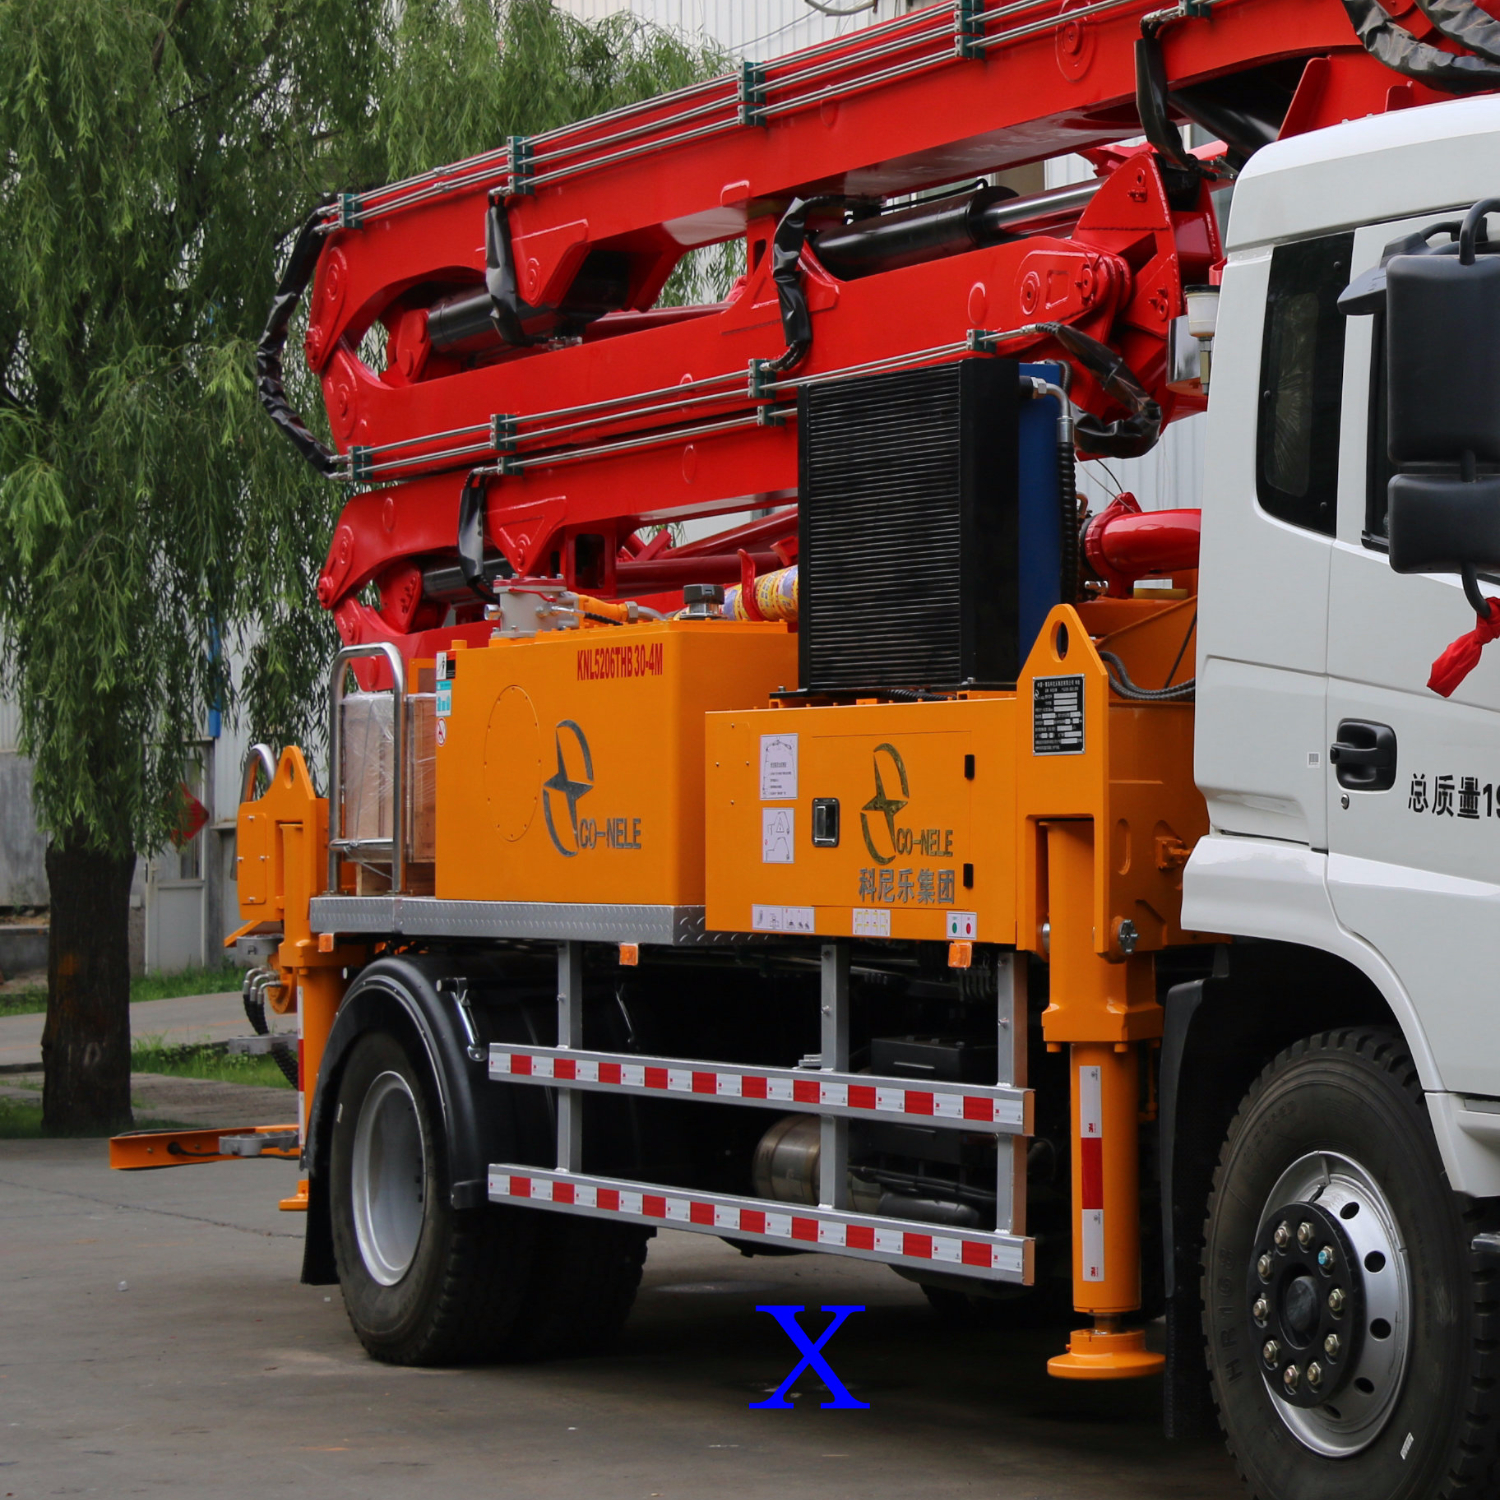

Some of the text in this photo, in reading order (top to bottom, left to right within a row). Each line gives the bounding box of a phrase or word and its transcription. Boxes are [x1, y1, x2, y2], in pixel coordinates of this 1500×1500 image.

[577, 645, 633, 681] KNL5206THB
[858, 867, 956, 905] 科尼乐集团
